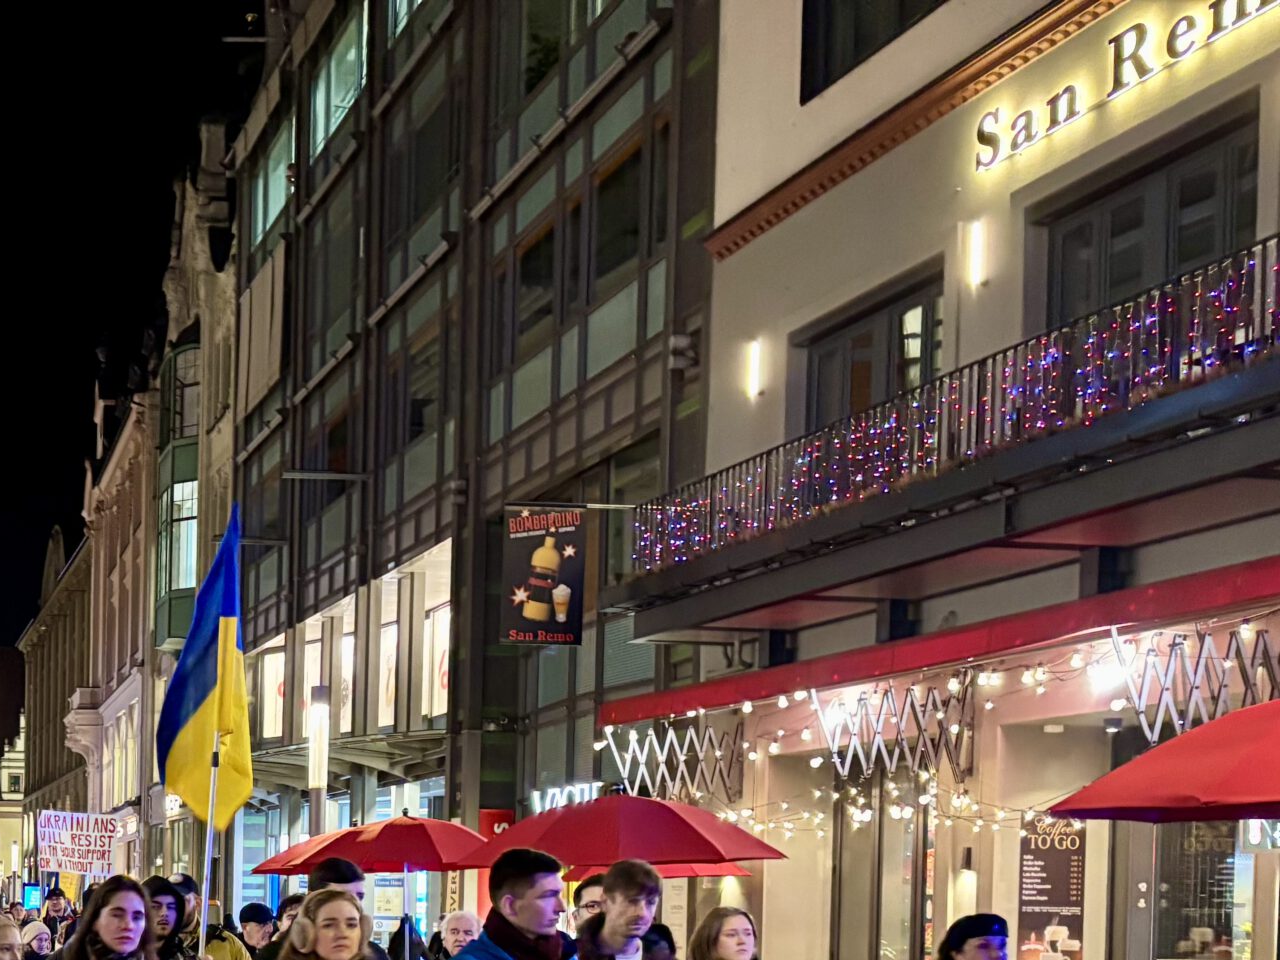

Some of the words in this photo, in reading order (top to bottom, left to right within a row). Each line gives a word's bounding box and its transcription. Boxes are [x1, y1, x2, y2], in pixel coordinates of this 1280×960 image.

[975, 84, 1081, 172] San
[508, 510, 581, 533] BOMBARDINO
[508, 629, 534, 641] San
[537, 630, 575, 642] Remo
[39, 813, 117, 834] UKRAINIANS
[70, 833, 115, 849] RESIST
[1027, 834, 1051, 849] TO
[1054, 835, 1080, 850] GO
[77, 848, 112, 862] SUPPORT
[101, 862, 113, 875] IT
